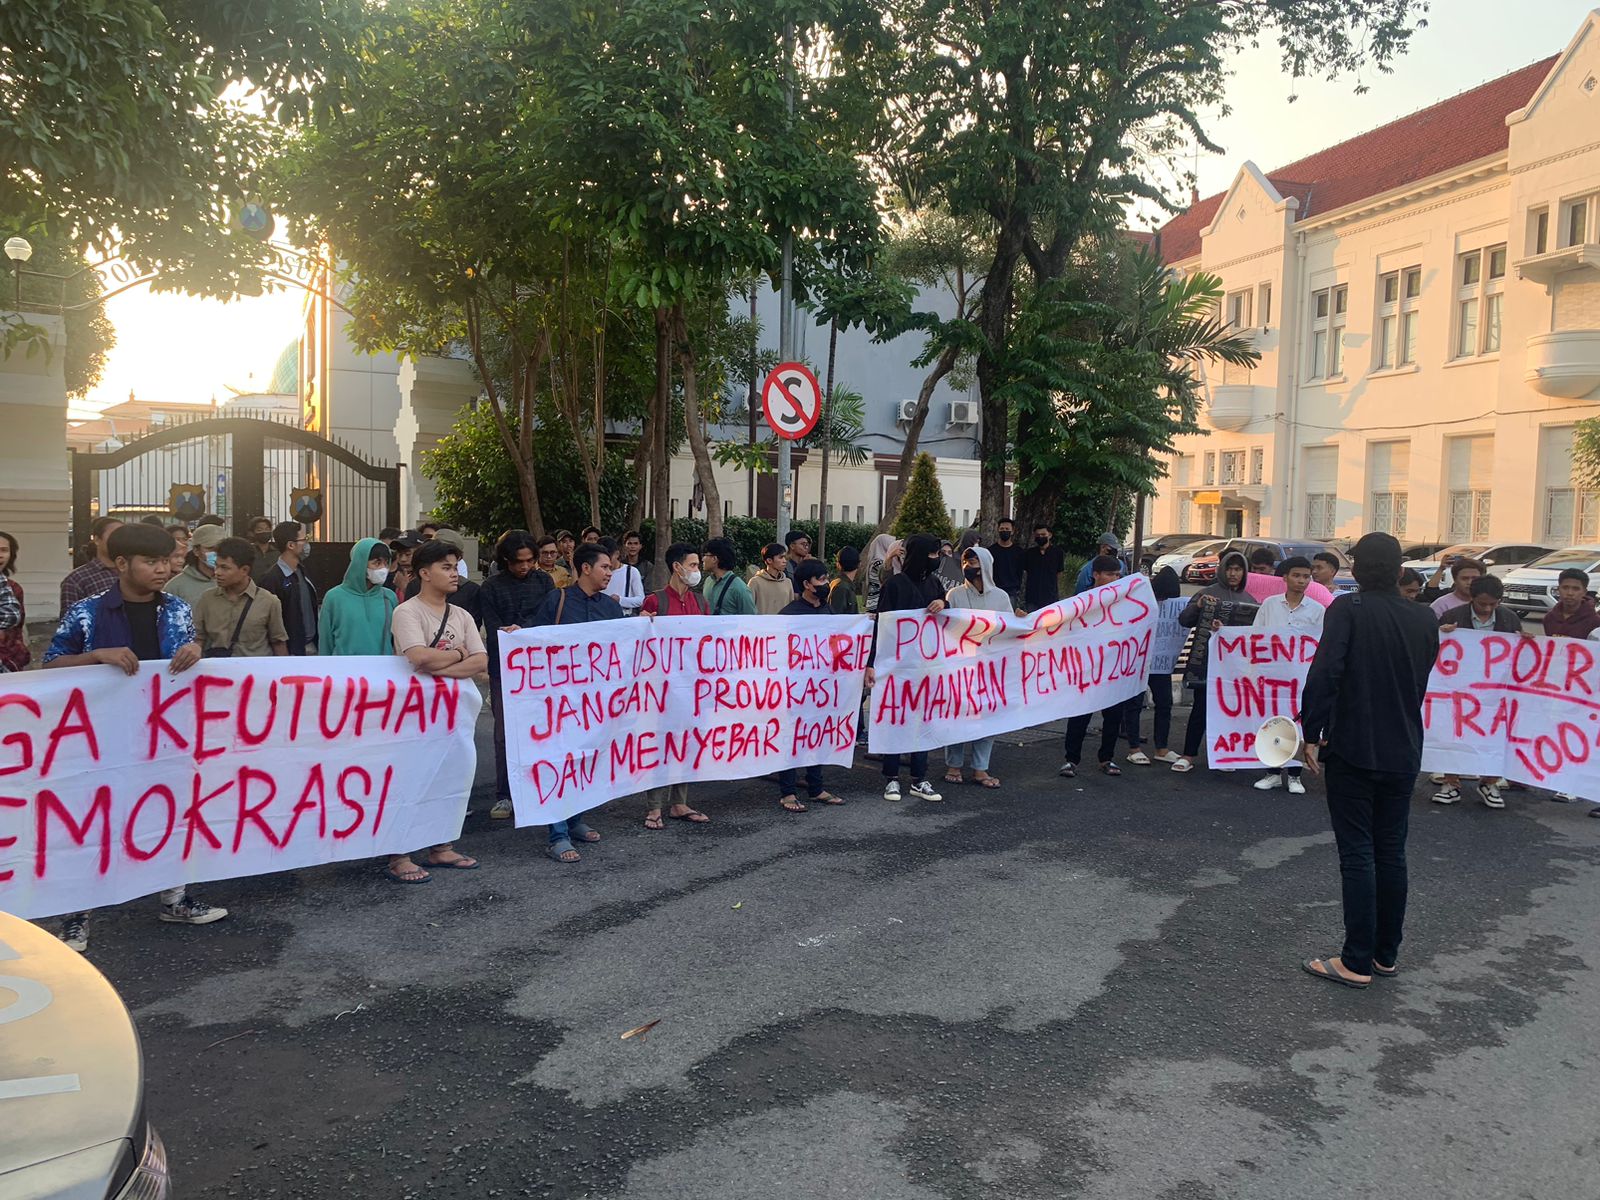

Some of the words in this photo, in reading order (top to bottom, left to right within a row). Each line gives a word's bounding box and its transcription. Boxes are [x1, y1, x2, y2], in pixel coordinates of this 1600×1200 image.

[781, 377, 803, 424] S
[1016, 578, 1149, 639] SUKSES
[507, 641, 623, 694] SEGERA
[633, 636, 693, 678] USUT
[696, 634, 778, 674] CONNIE
[787, 633, 872, 673] BAKRIE
[876, 656, 1007, 726] AMANKAN
[1021, 645, 1105, 704] PEMILU
[1107, 628, 1152, 681] 2024
[1480, 635, 1597, 695] POLR
[146, 671, 460, 764] KEUTUHAN
[530, 679, 669, 741] JANGAN
[693, 675, 839, 717] PROVOKASI
[1216, 676, 1302, 725] UNTU
[1423, 691, 1532, 744] TRAL
[531, 749, 599, 804] DAN
[610, 717, 781, 783] MENYEBAR
[792, 710, 855, 757] HOAKS
[1515, 713, 1600, 782] 100
